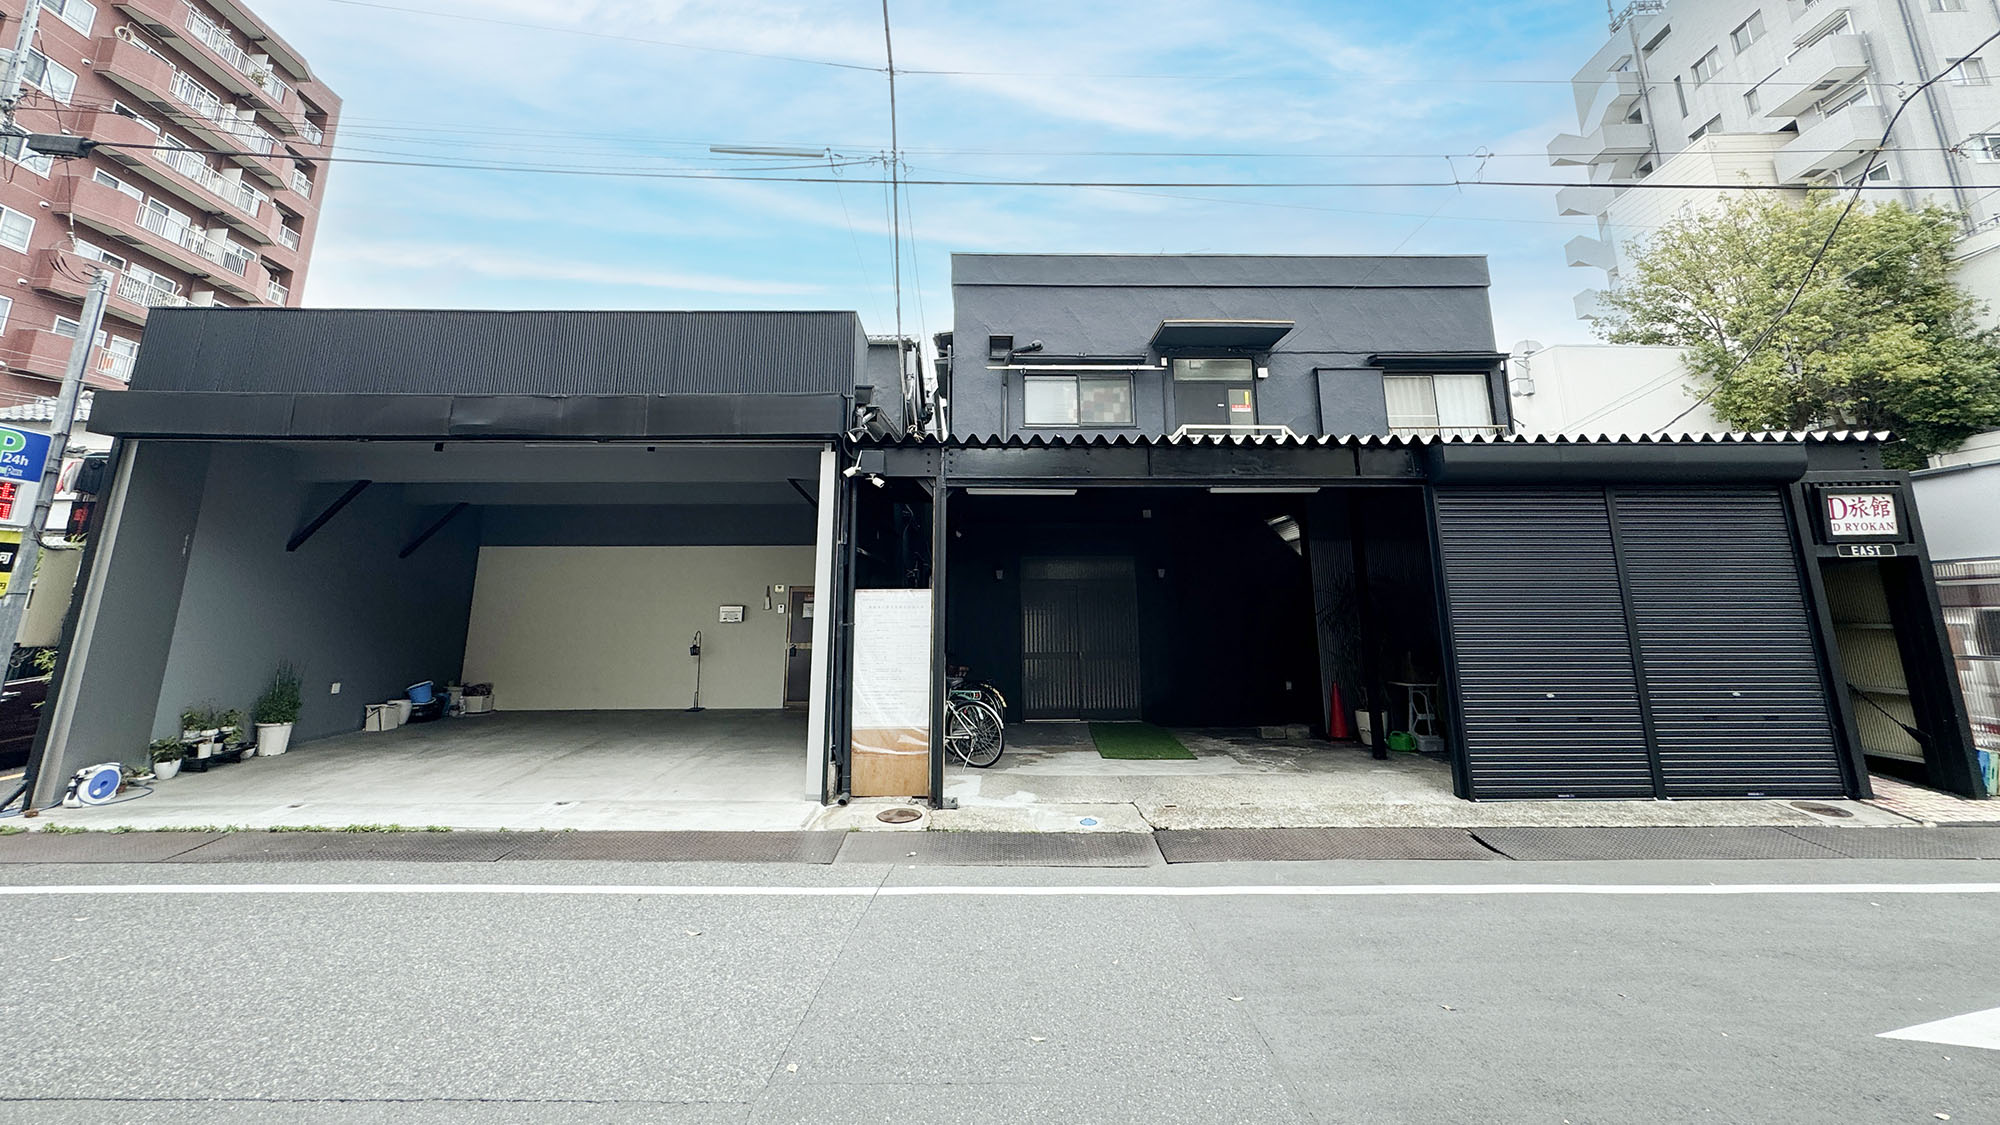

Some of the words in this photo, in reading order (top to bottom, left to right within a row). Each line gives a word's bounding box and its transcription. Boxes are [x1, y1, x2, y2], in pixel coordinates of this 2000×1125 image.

[2, 452, 29, 466] 24h
[1828, 496, 1891, 520] D旅館
[1833, 523, 1841, 532] D
[1845, 522, 1895, 531] RYOKAN
[1850, 545, 1881, 556] EAST
